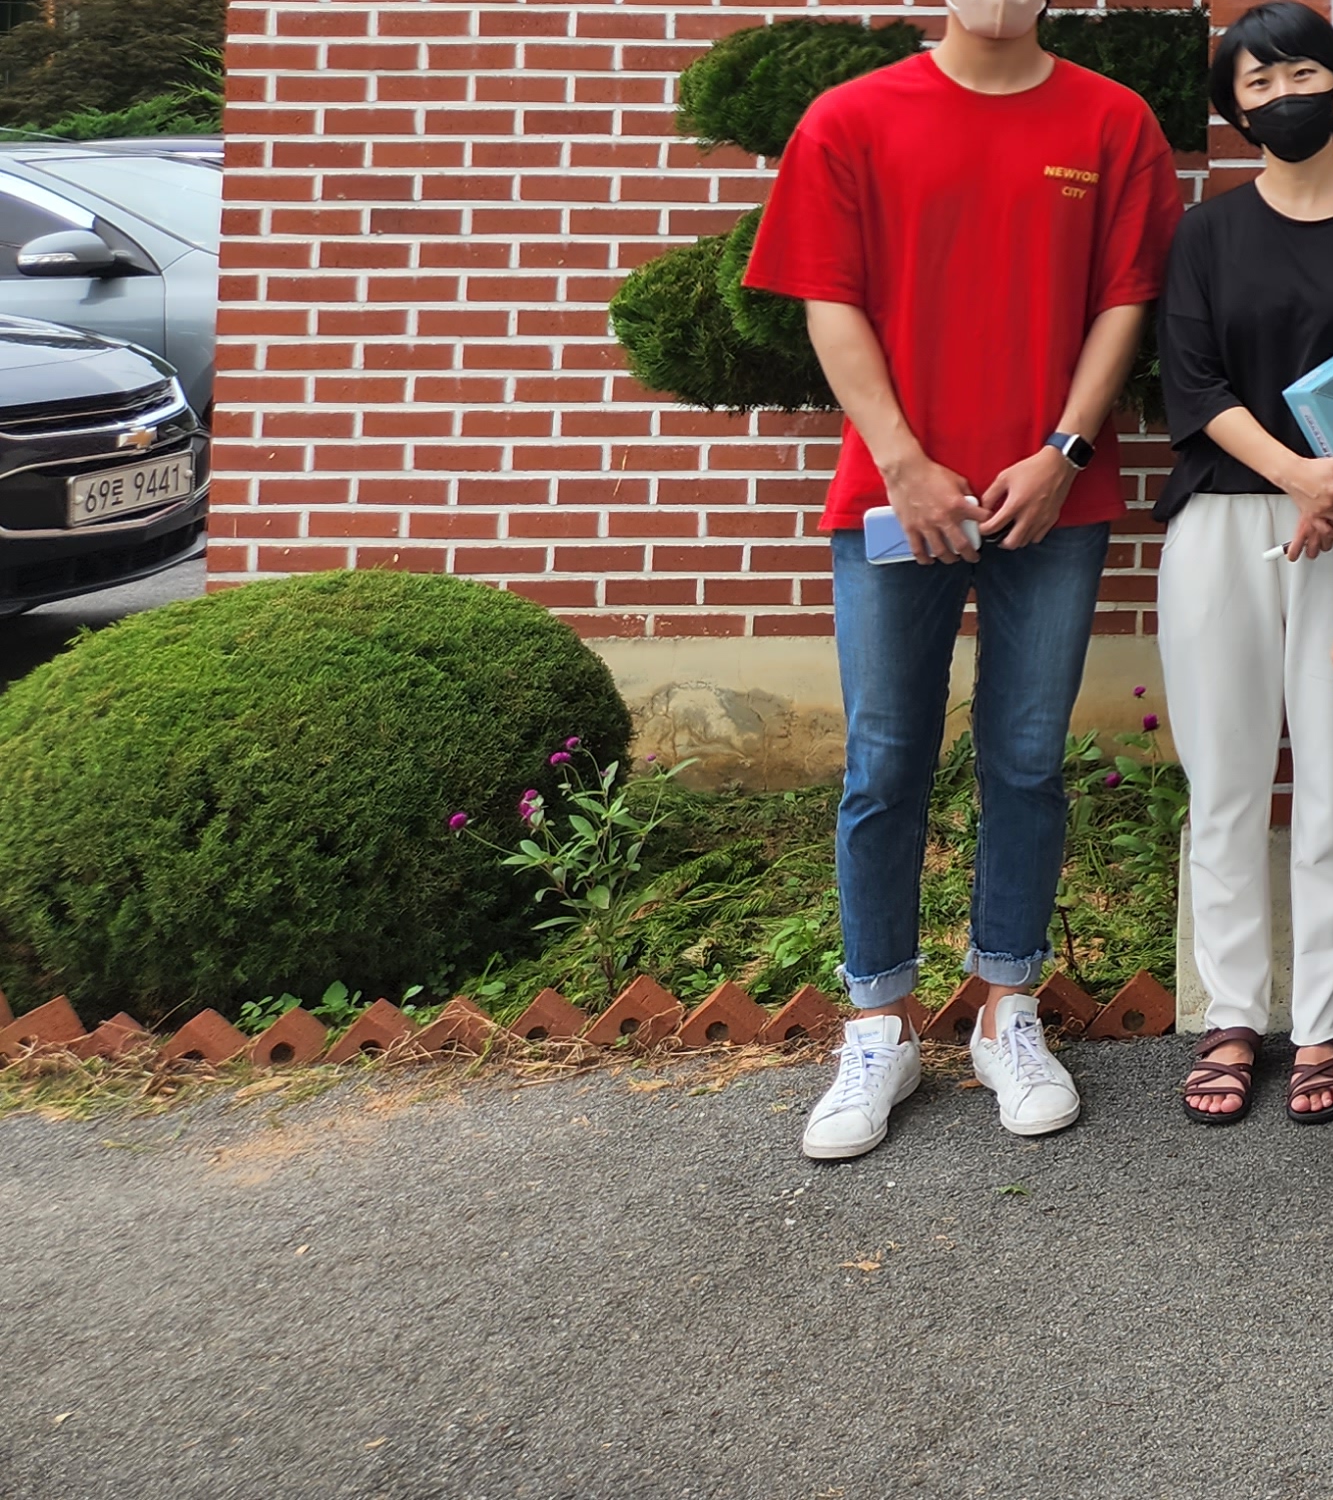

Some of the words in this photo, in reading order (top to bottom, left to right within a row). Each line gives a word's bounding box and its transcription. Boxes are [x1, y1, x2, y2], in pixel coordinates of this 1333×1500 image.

[1061, 186, 1087, 199] CITY
[85, 476, 124, 514] 69로
[133, 463, 181, 502] 9441
